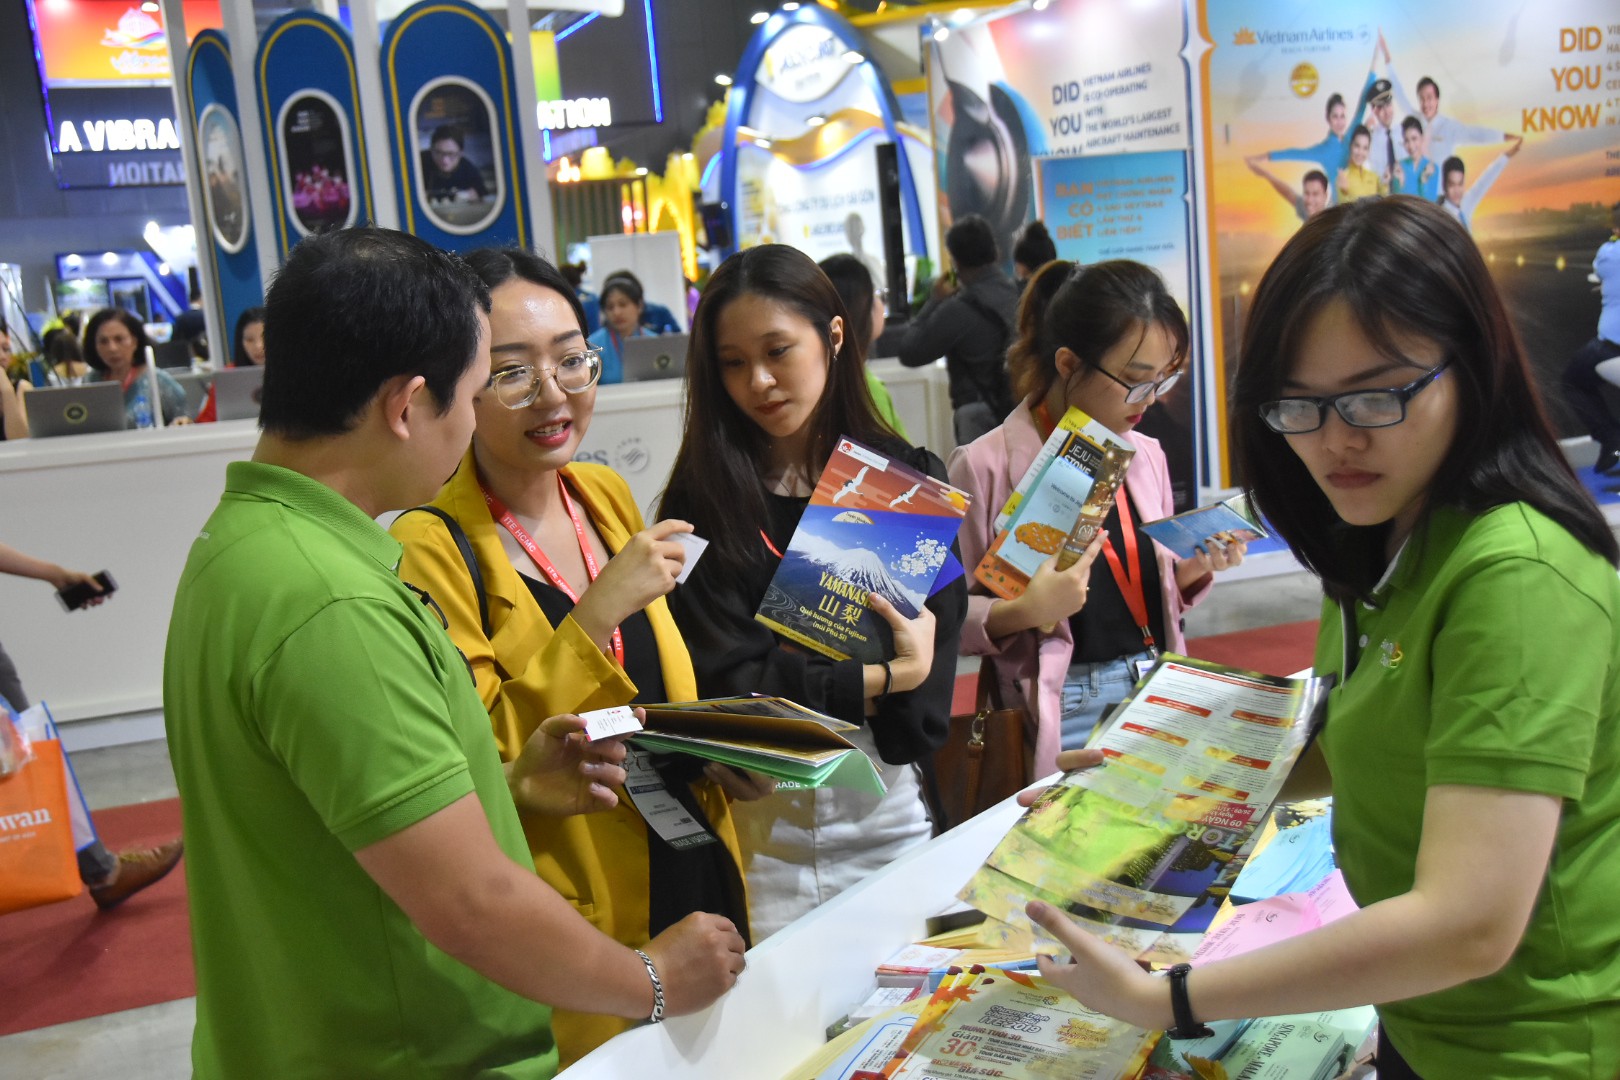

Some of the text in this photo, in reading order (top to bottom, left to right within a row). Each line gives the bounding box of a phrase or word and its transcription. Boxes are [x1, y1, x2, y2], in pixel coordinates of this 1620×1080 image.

[1559, 26, 1602, 53] DID
[1083, 62, 1152, 87] VIETNAM AIRLINES
[1550, 64, 1602, 92] YOU
[1052, 81, 1081, 105] DID
[1050, 111, 1082, 137] YOU
[1136, 107, 1172, 122] LARGEST
[1521, 102, 1602, 133] KNOW
[59, 118, 181, 152] A VIBRA
[1086, 122, 1181, 148] AIRCRAFT MAINTENANCE
[1068, 444, 1091, 463] JEJU
[503, 516, 537, 553] ITE HCMC
[546, 565, 558, 580] ITE
[845, 626, 868, 642] Fujisan
[1004, 1021, 1042, 1034] 2019
